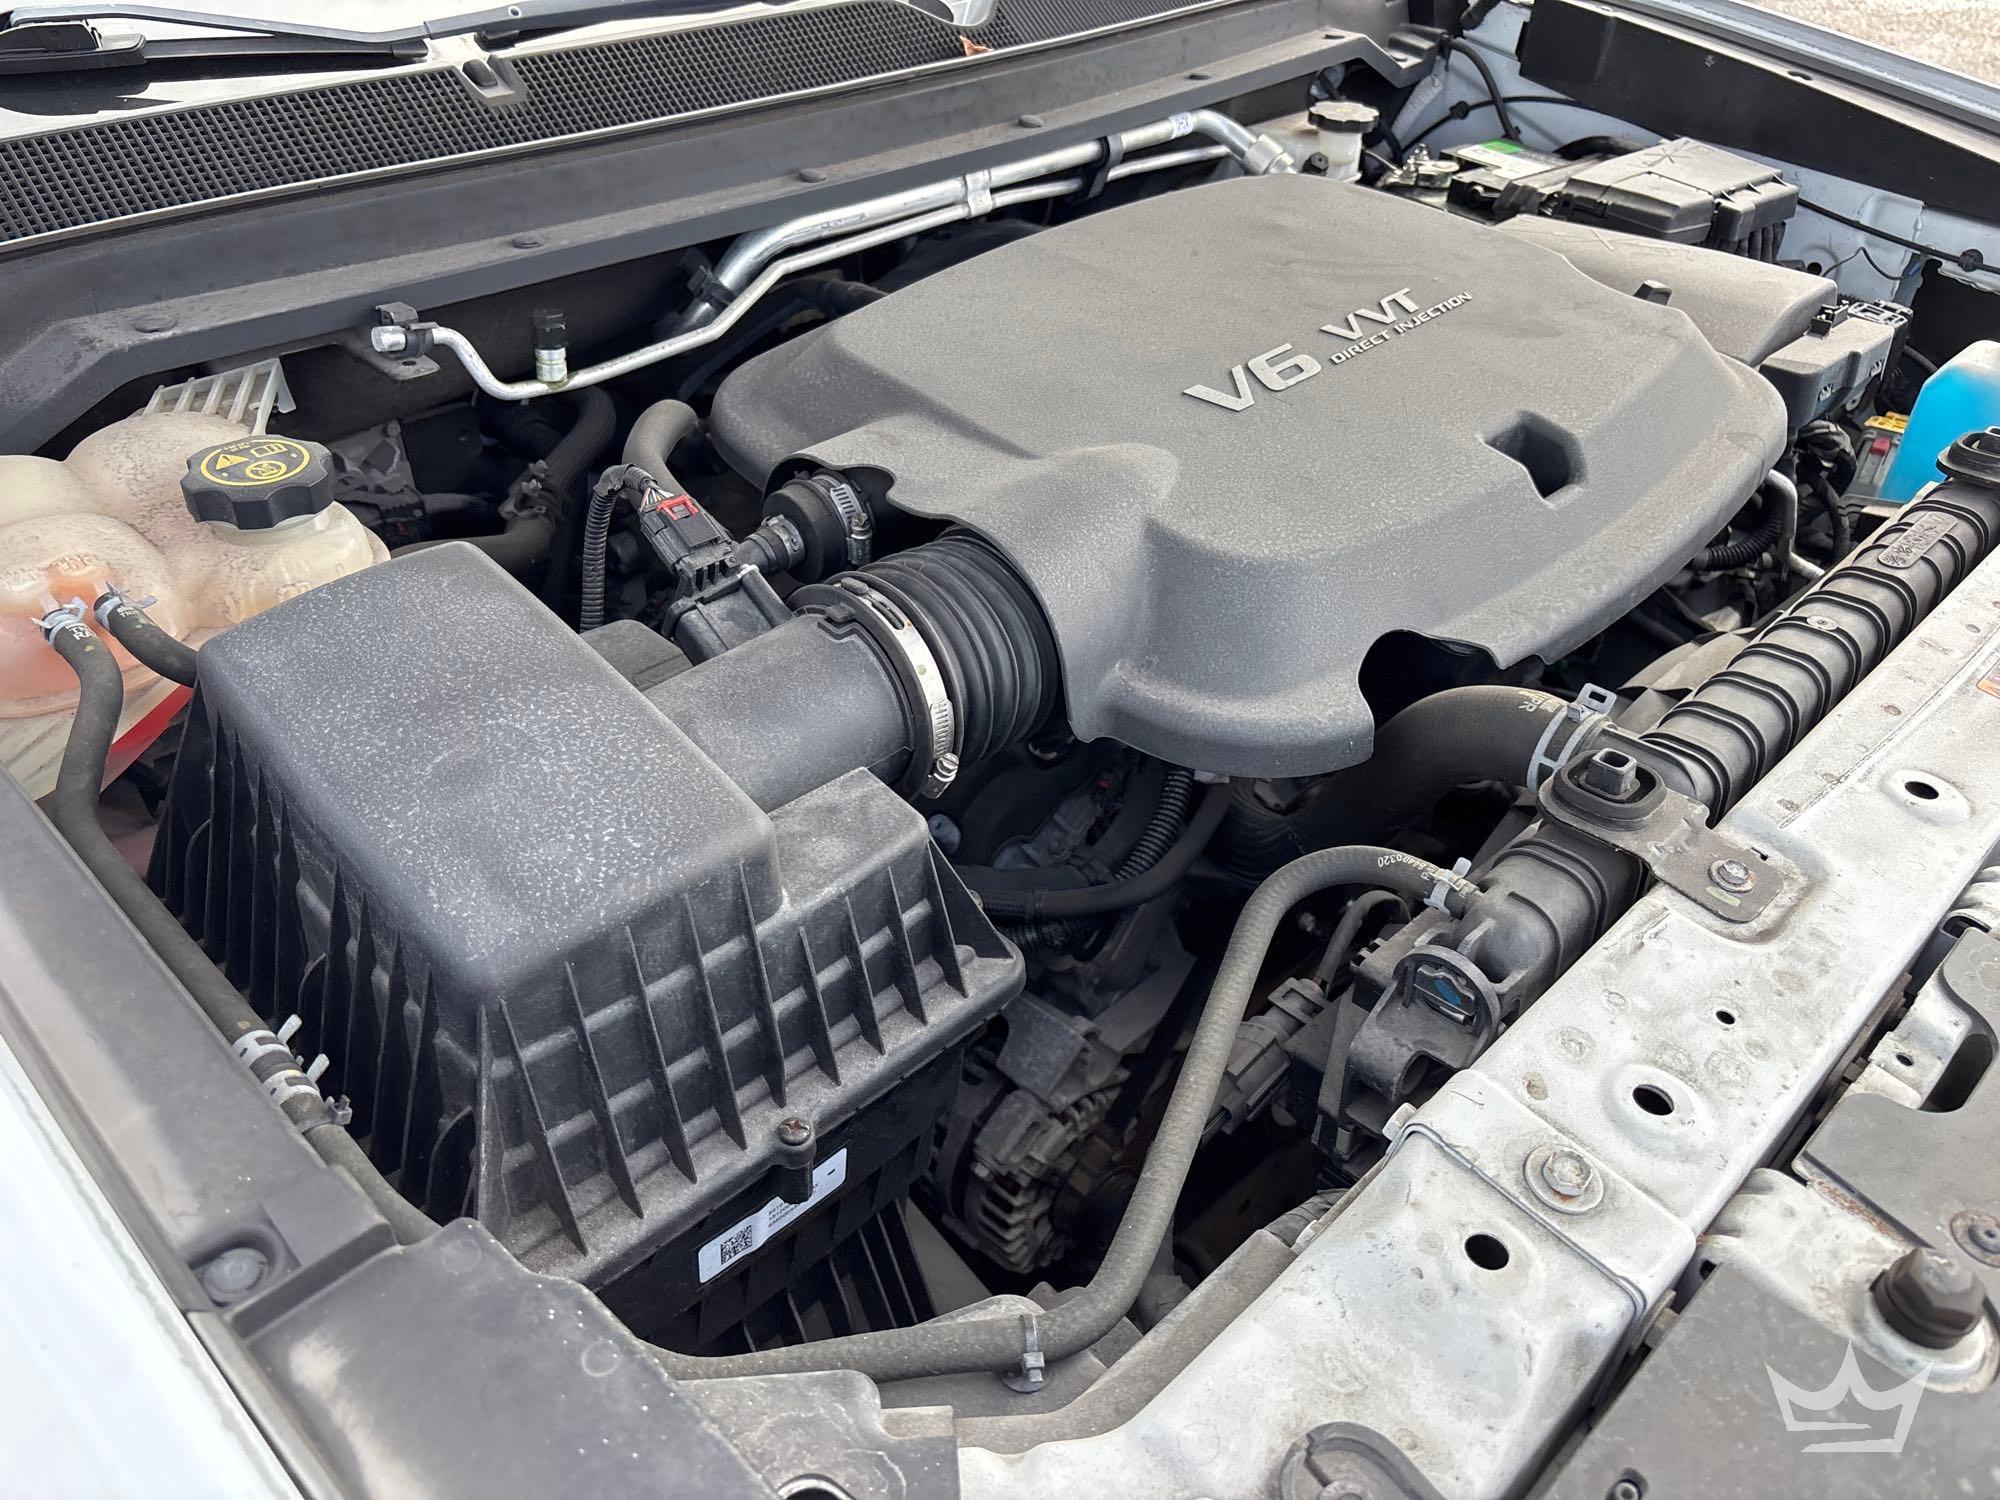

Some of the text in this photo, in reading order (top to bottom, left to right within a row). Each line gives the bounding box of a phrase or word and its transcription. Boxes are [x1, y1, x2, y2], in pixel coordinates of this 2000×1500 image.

[1182, 287, 1419, 412] V6 VVT
[1330, 291, 1473, 365] DIRECT INJECTION
